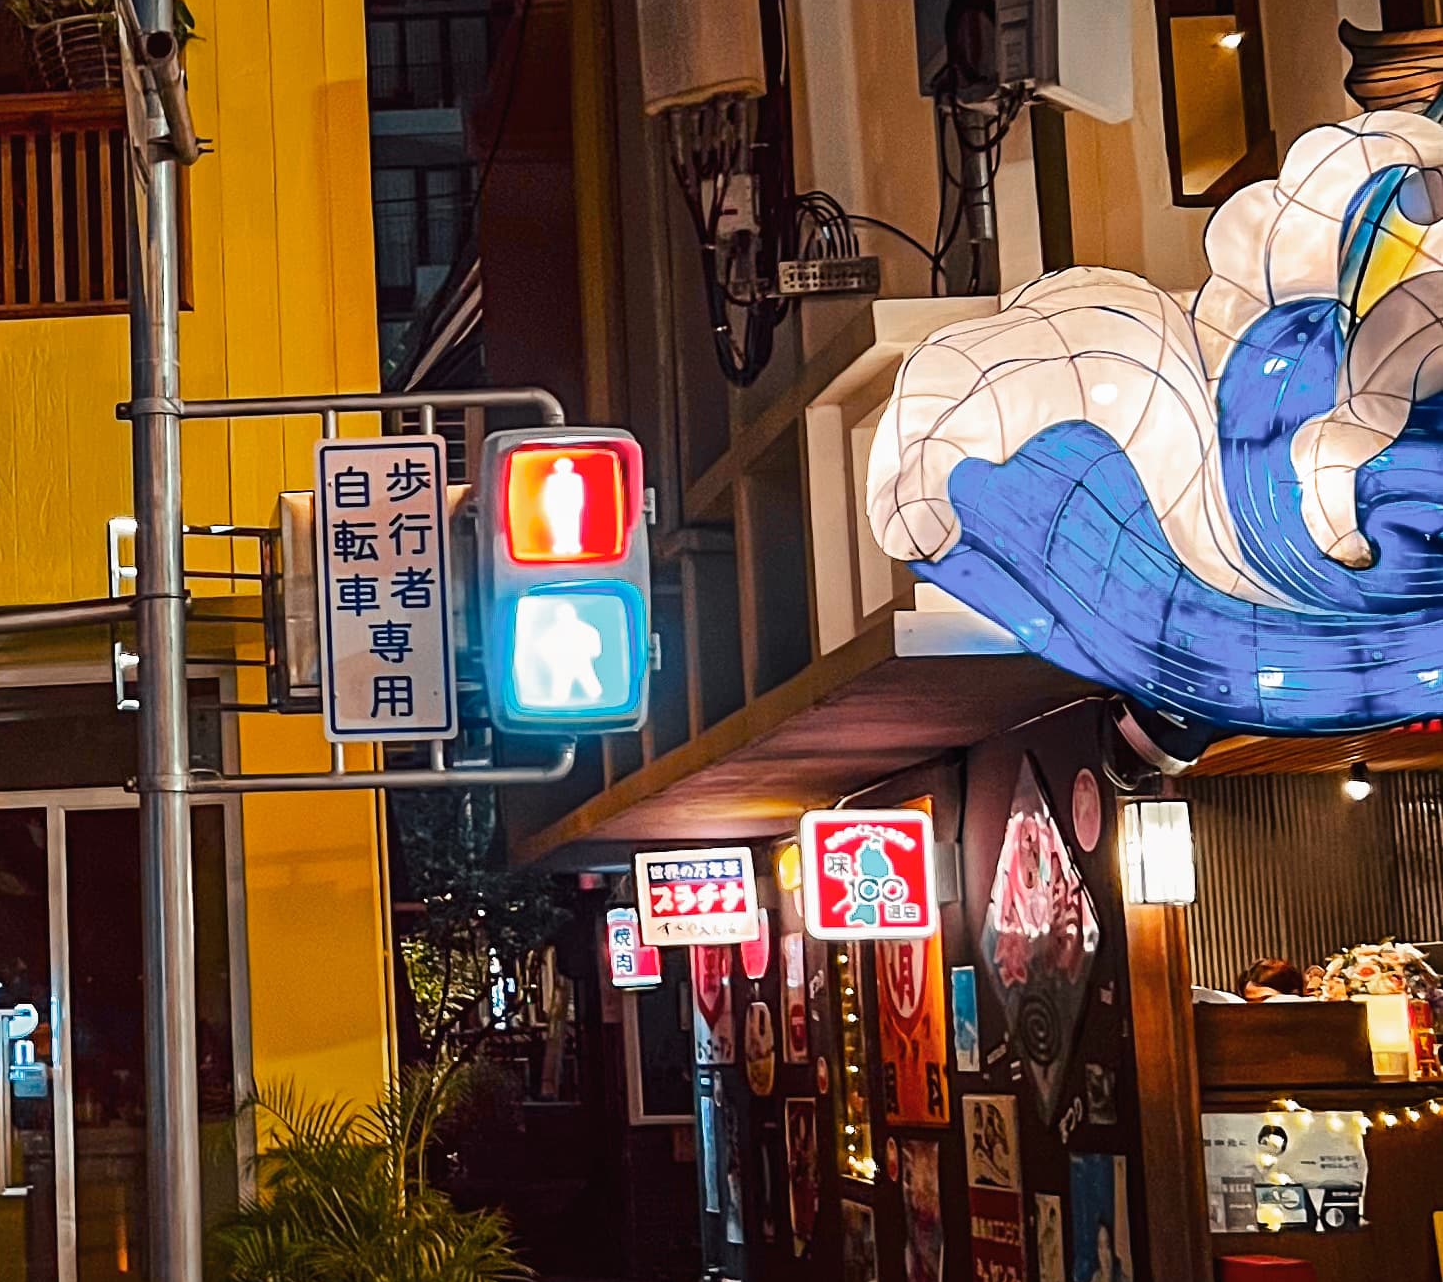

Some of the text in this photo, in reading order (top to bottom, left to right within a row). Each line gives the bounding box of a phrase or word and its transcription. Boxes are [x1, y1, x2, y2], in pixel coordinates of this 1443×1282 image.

[332, 466, 380, 617] 自転車
[386, 459, 435, 609] 歩行者
[368, 619, 413, 718] 専用
